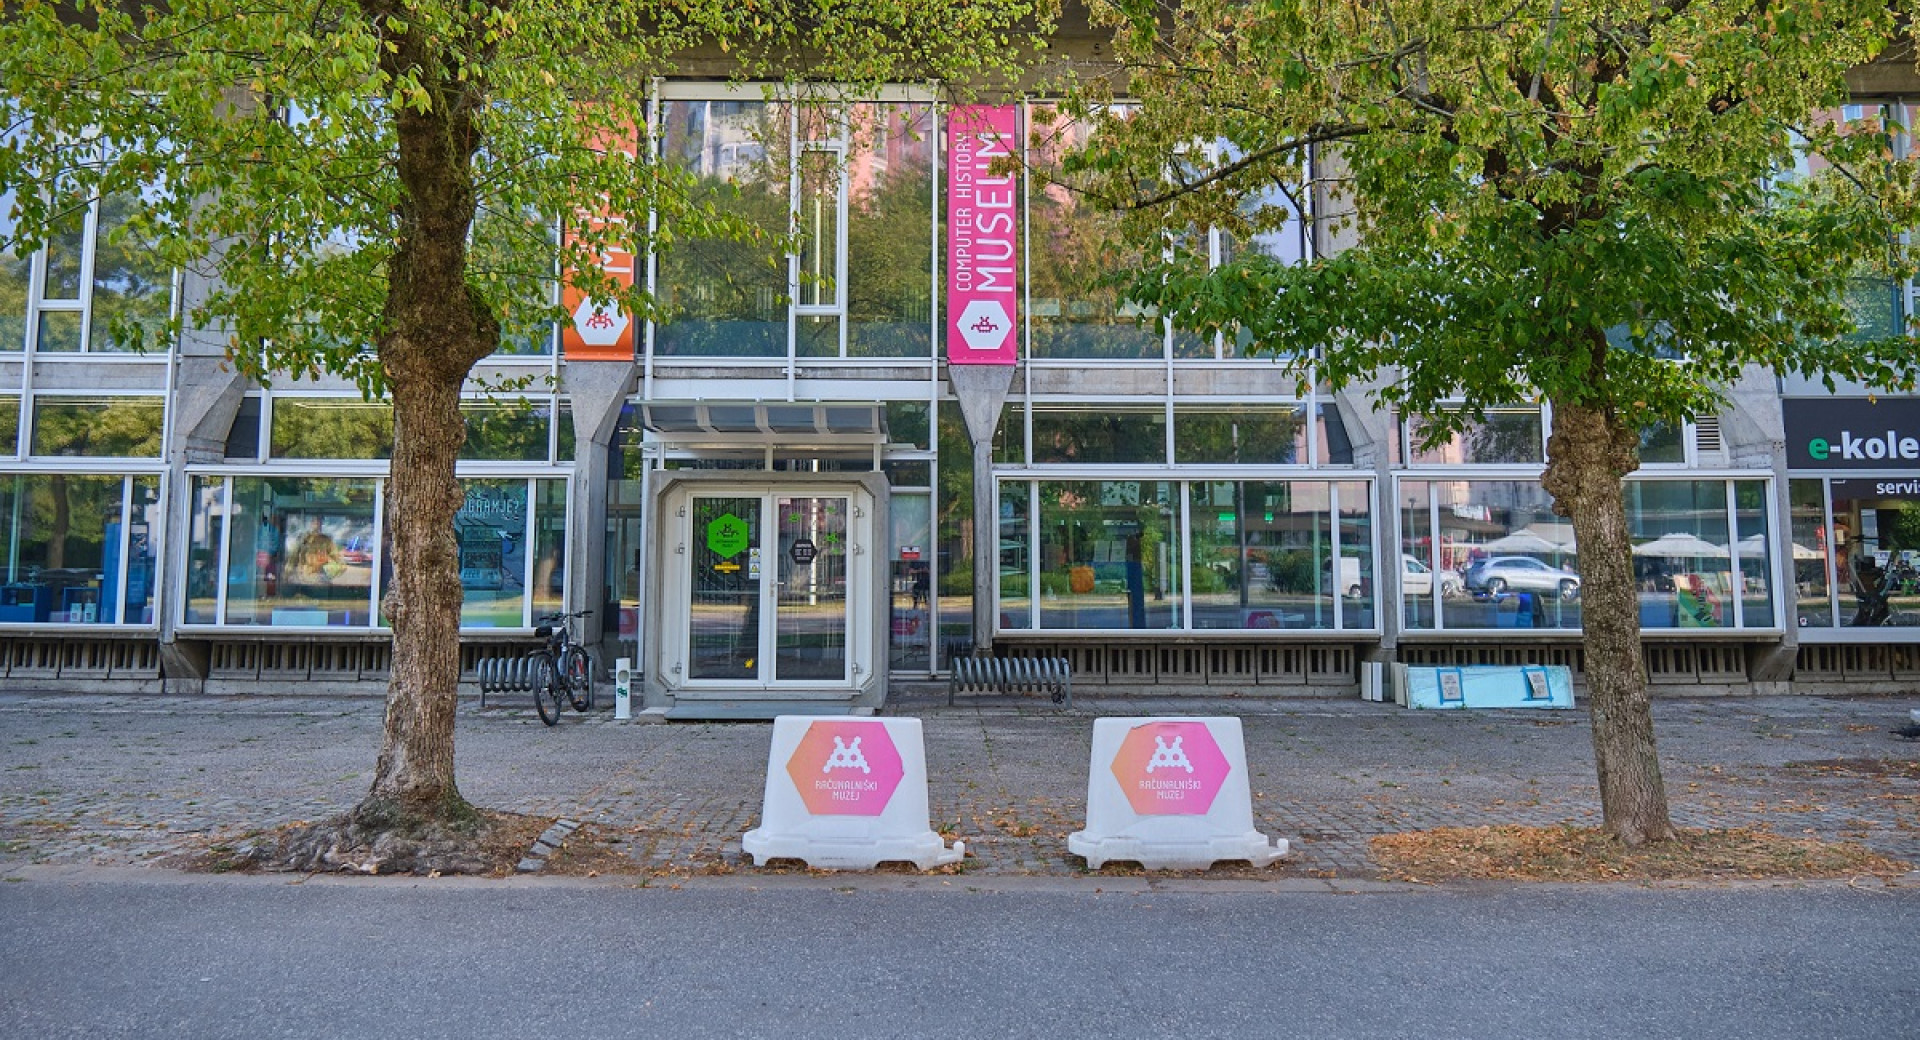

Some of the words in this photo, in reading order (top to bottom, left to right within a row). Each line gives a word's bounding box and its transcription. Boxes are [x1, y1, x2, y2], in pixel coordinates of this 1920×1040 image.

[955, 132, 972, 198] HISTORY
[975, 132, 1014, 292] MUSEUM
[956, 207, 972, 291] COMPUTER
[1876, 479, 1920, 495] servi
[815, 778, 878, 791] RAČUNALNIŠKI
[1138, 778, 1202, 790] RAČUNALNIŠKI
[831, 791, 860, 801] MUZEJ
[1156, 790, 1185, 800] MUZEJ
